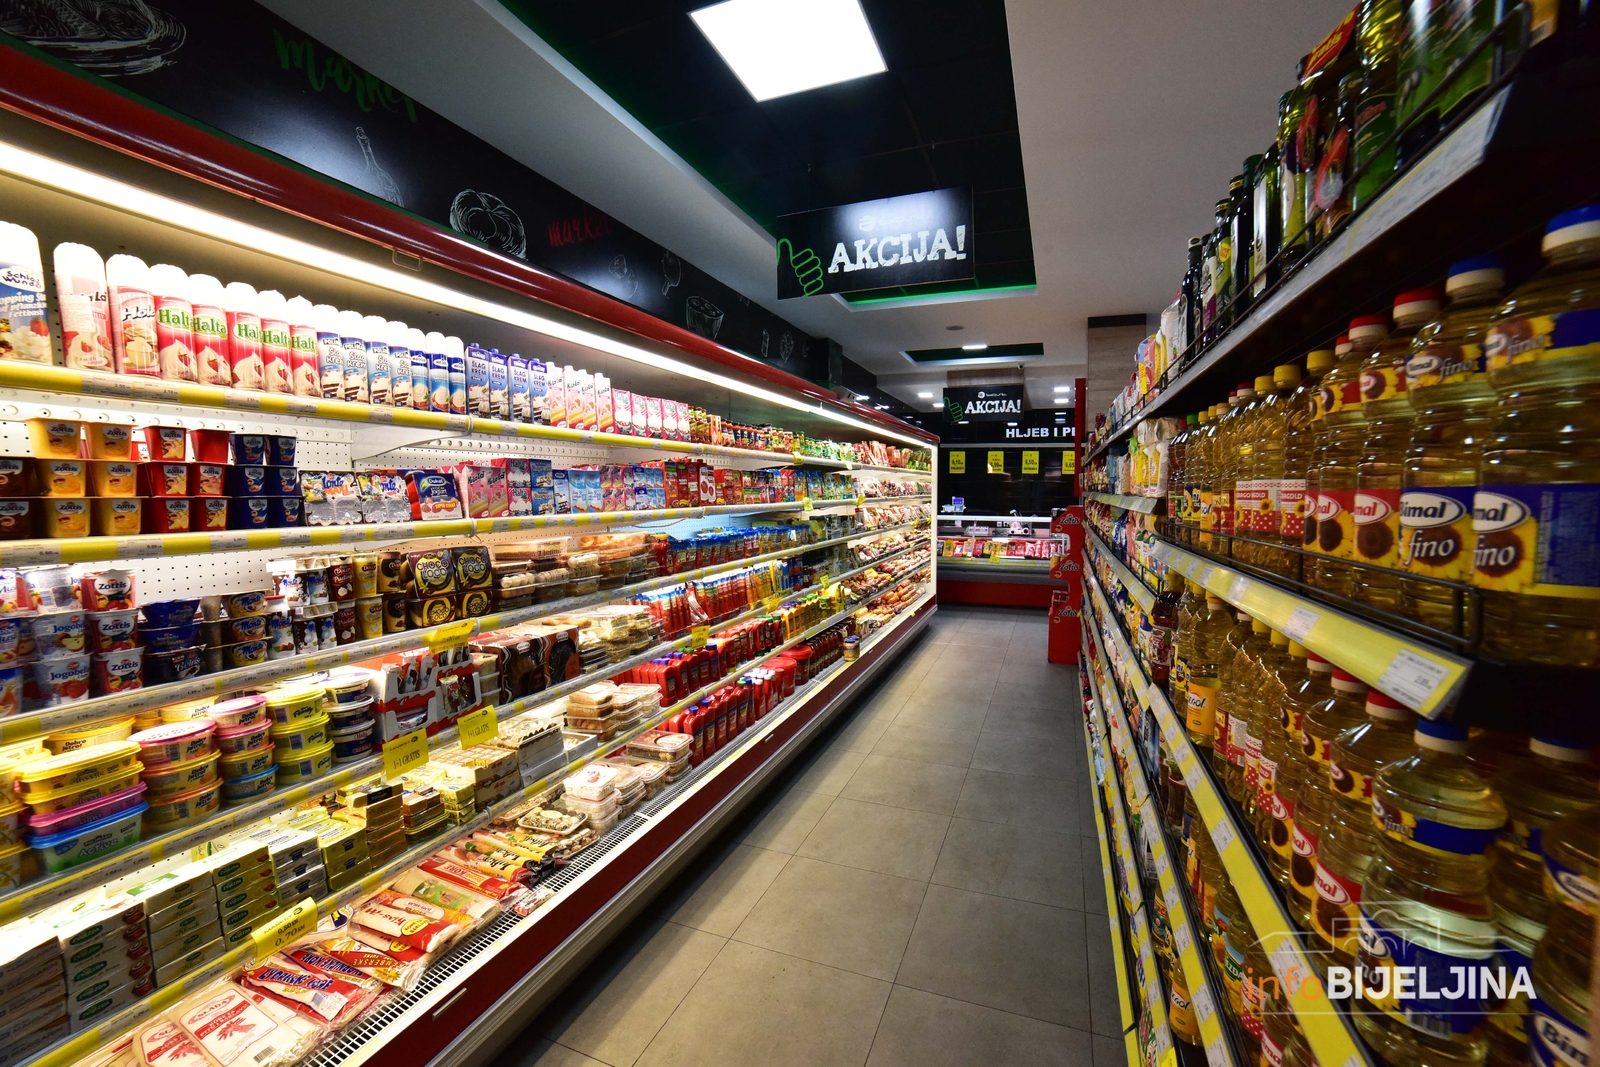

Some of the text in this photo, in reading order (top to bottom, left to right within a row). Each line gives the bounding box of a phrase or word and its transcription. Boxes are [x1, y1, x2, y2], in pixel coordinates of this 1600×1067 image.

[828, 225, 967, 274] AKCIJA!
[471, 368, 487, 376] KREM
[1438, 357, 1474, 382] fino
[965, 399, 1021, 414] AKCIJA!
[1005, 427, 1049, 437] HLJEB
[1405, 530, 1455, 566] fino
[416, 560, 449, 571] CHOCO
[459, 557, 487, 565] CHOCO
[463, 563, 486, 573] LOCO
[422, 568, 448, 579] LOCO
[98, 581, 127, 590] Zottis
[102, 622, 131, 631] Zottis
[111, 661, 139, 671] Zottis
[241, 709, 258, 719] Dobro
[475, 723, 490, 736] GRATIS
[250, 731, 266, 741] Dobro
[190, 737, 207, 746] Dobro
[402, 750, 421, 765] GRATIS
[191, 765, 209, 774] Dobro
[78, 838, 119, 858] Active
[197, 999, 228, 1018] SLADA
